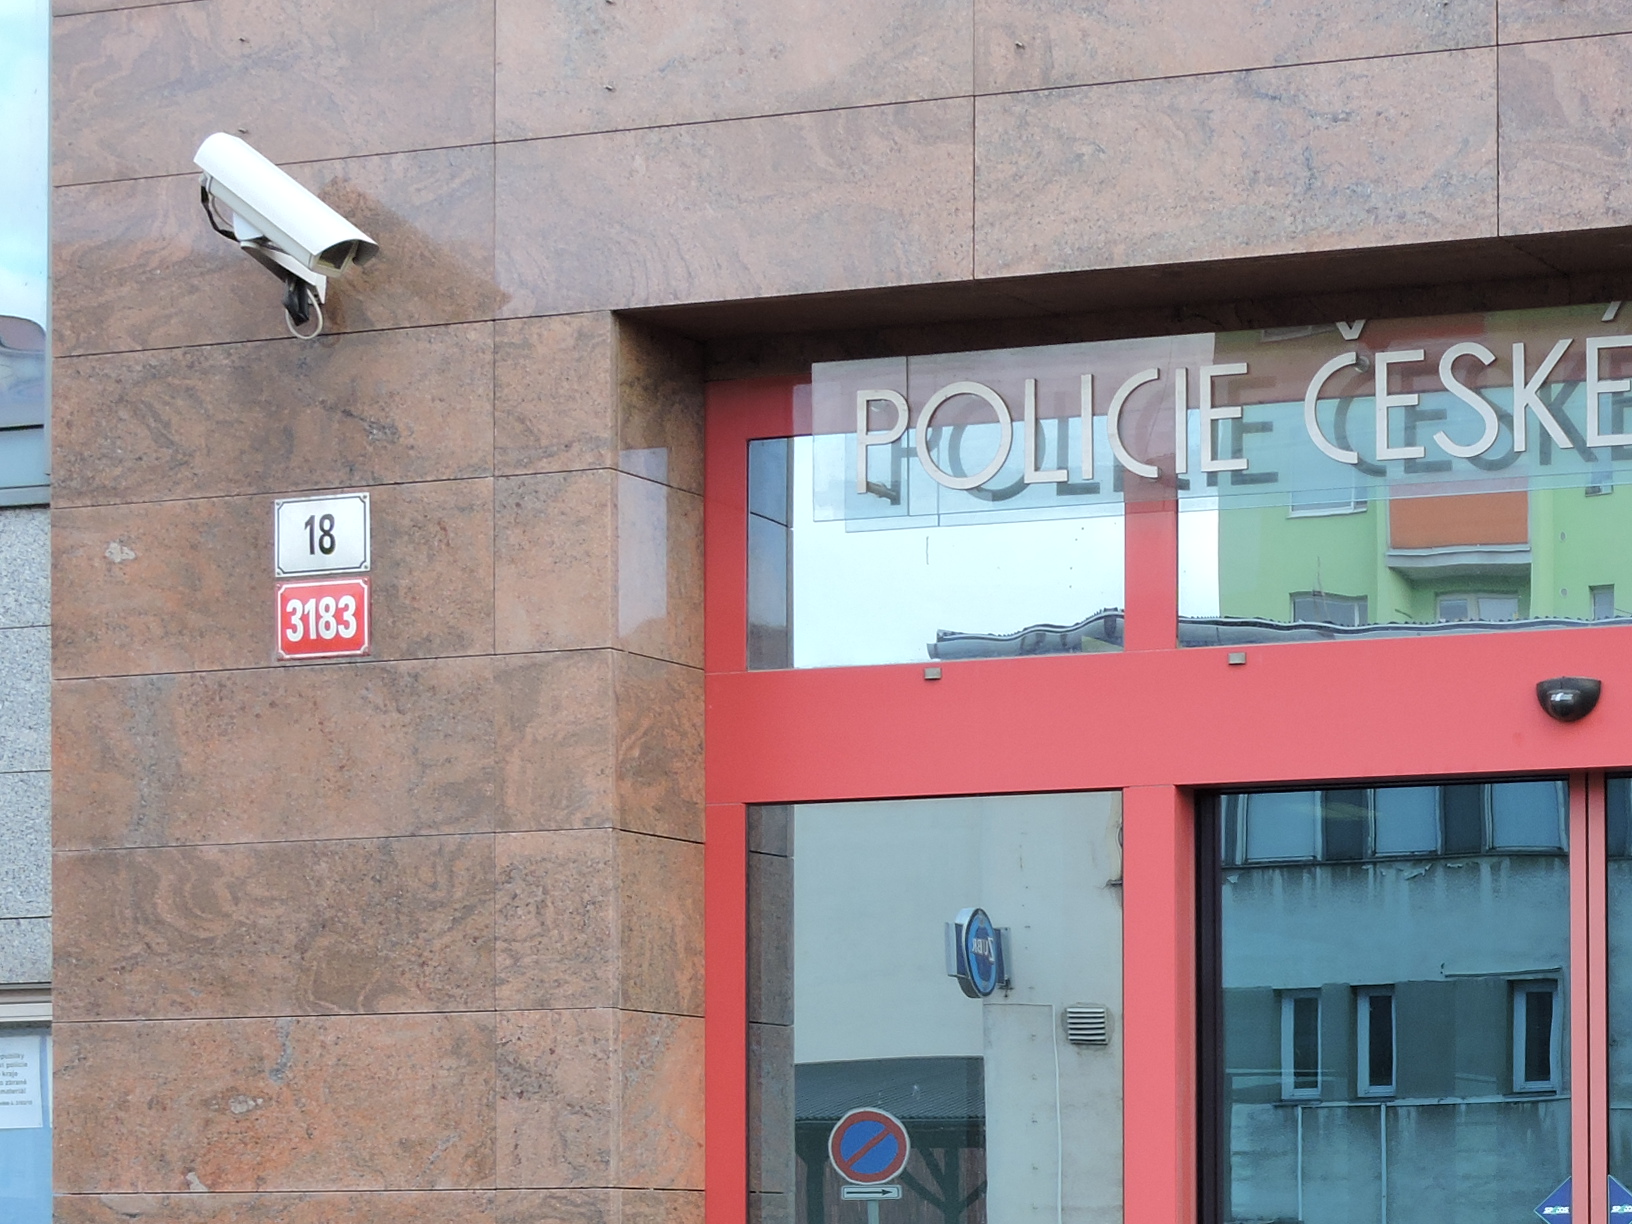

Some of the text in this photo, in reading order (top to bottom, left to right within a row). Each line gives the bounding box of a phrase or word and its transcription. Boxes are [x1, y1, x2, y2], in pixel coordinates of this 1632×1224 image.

[855, 361, 1249, 495] POLICIE
[304, 513, 336, 556] 18
[285, 594, 358, 643] 3183
